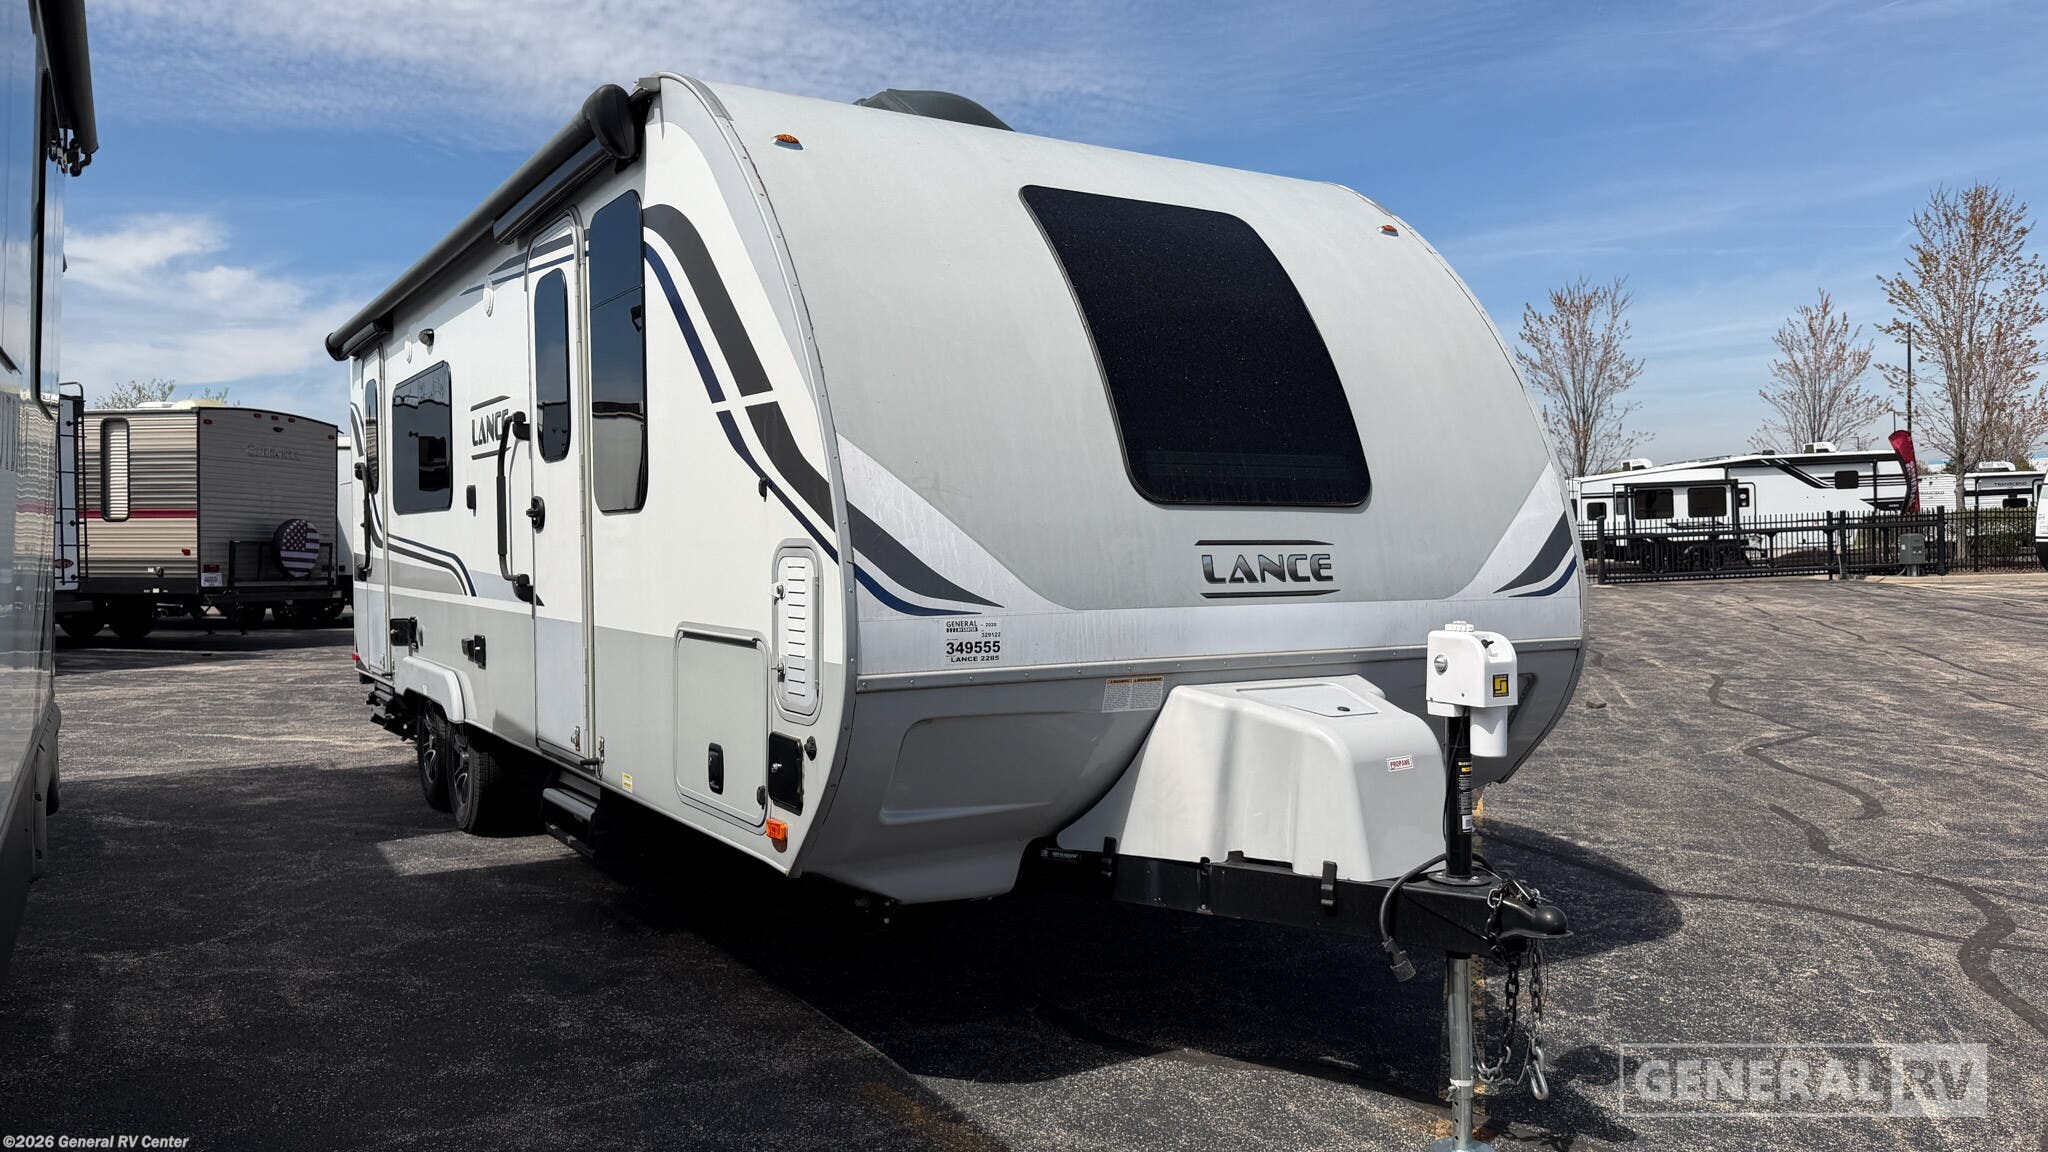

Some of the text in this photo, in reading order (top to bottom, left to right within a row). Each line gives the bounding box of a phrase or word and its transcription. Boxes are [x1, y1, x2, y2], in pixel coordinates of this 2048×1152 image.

[1201, 553, 1334, 584] LANCE
[946, 620, 978, 628] GENERAL
[946, 641, 1001, 655] 349555
